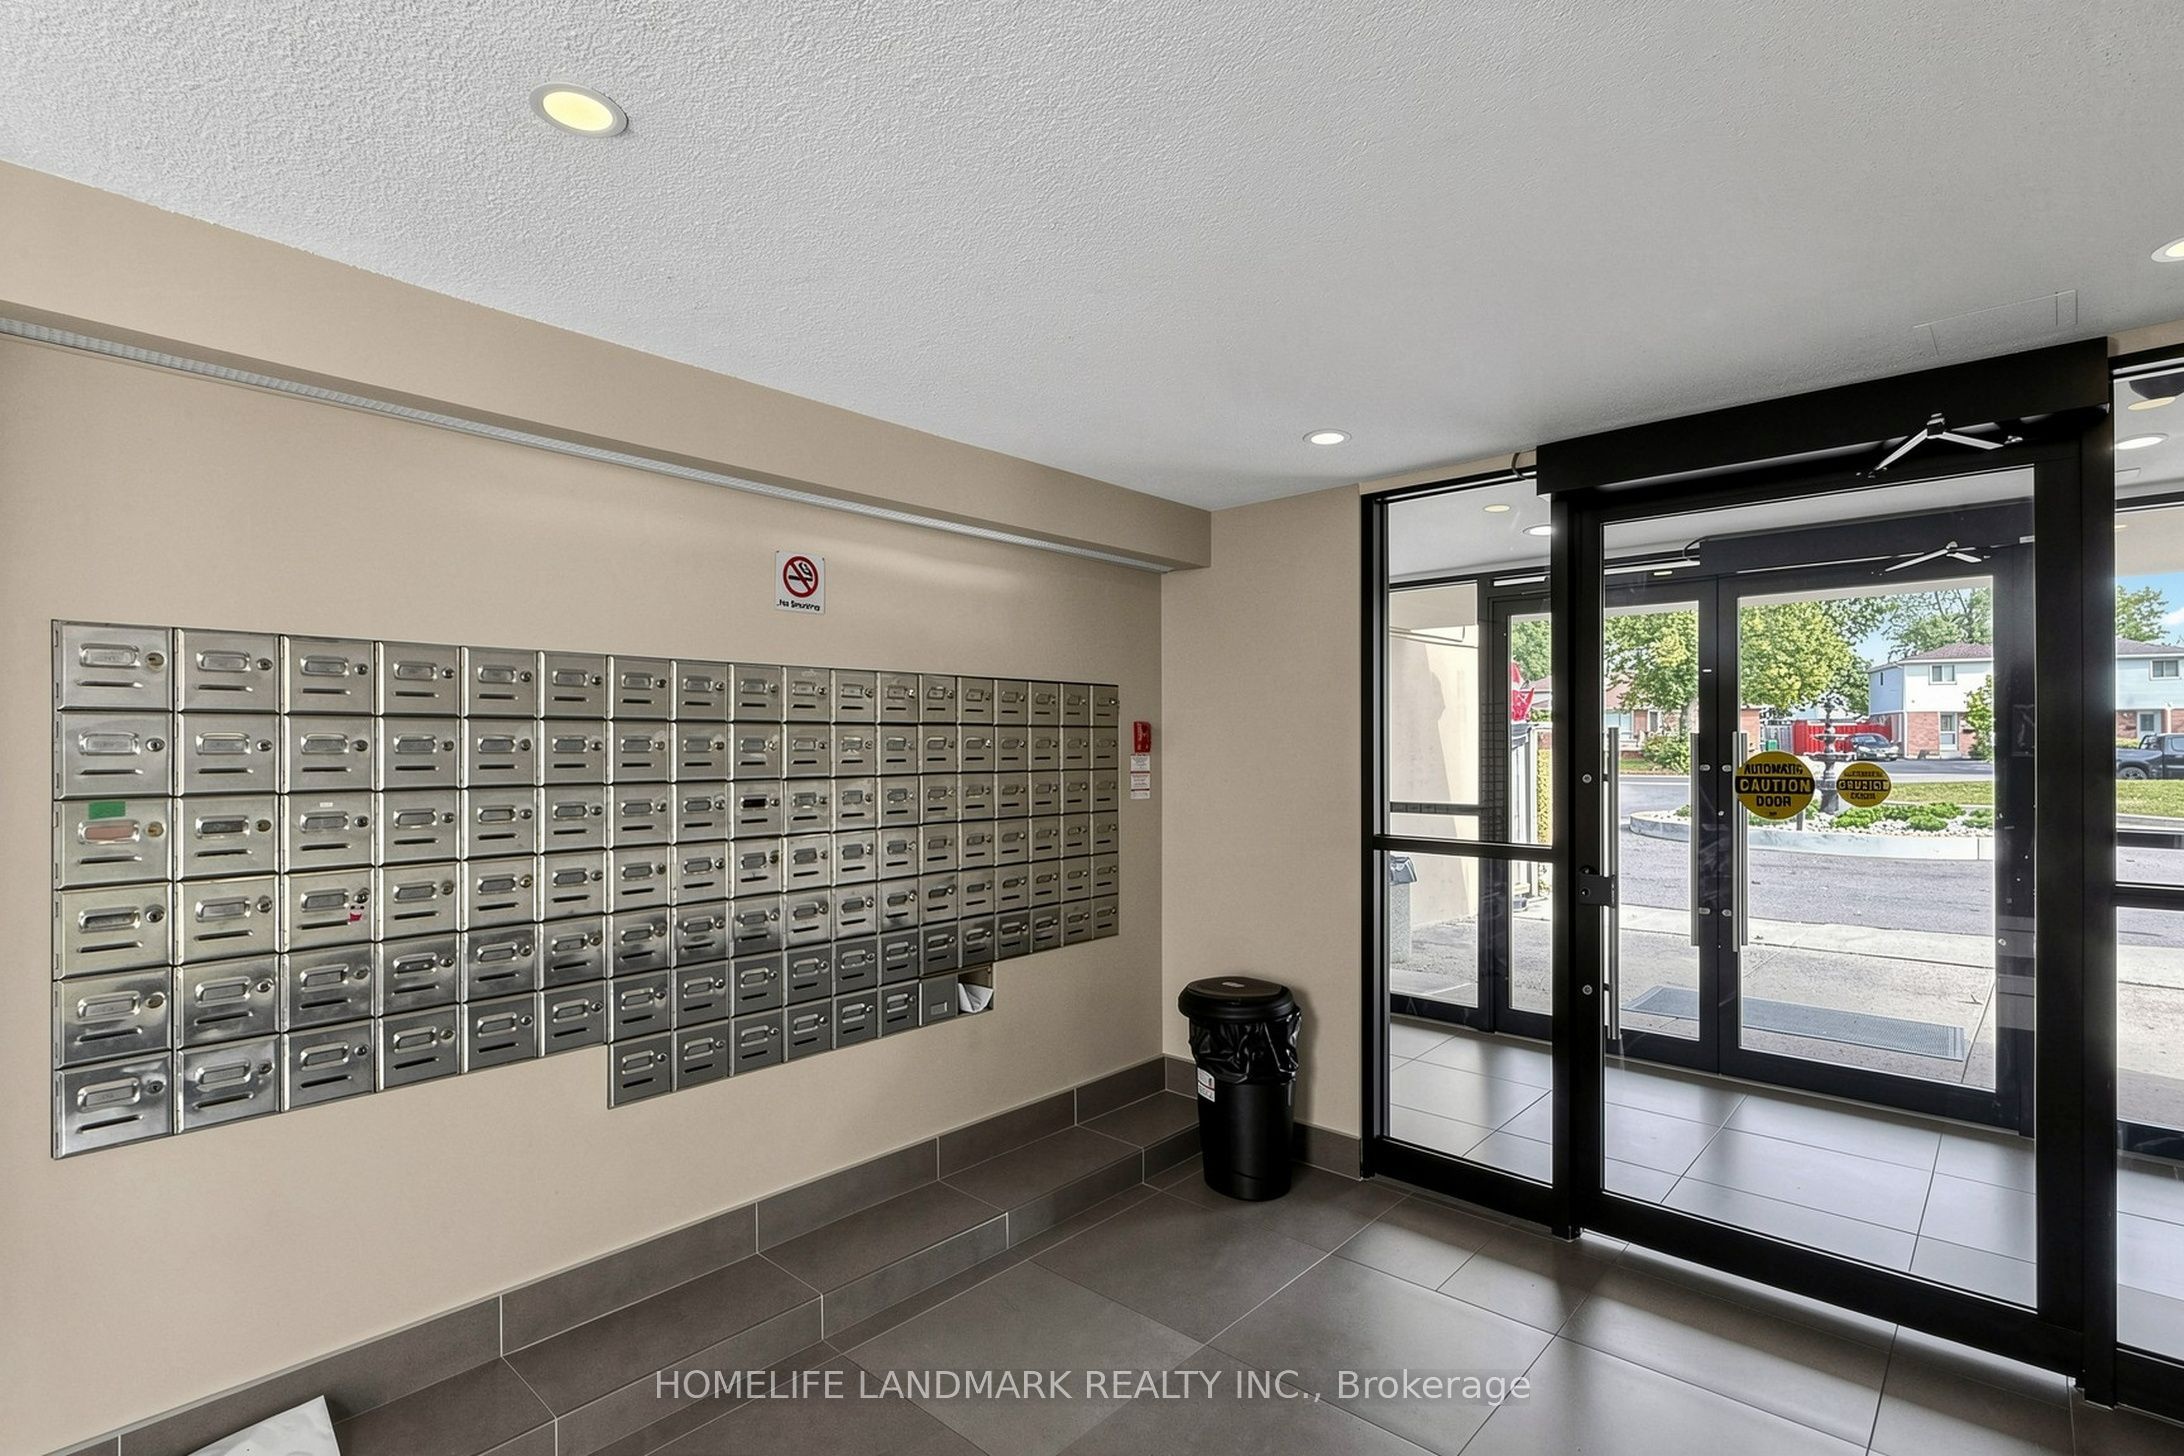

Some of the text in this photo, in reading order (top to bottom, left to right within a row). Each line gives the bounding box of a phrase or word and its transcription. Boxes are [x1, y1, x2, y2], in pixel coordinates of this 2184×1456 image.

[1744, 763, 1804, 775] AUTOMATIC
[1739, 778, 1812, 793] CAUTION
[1756, 795, 1792, 807] DOOR
